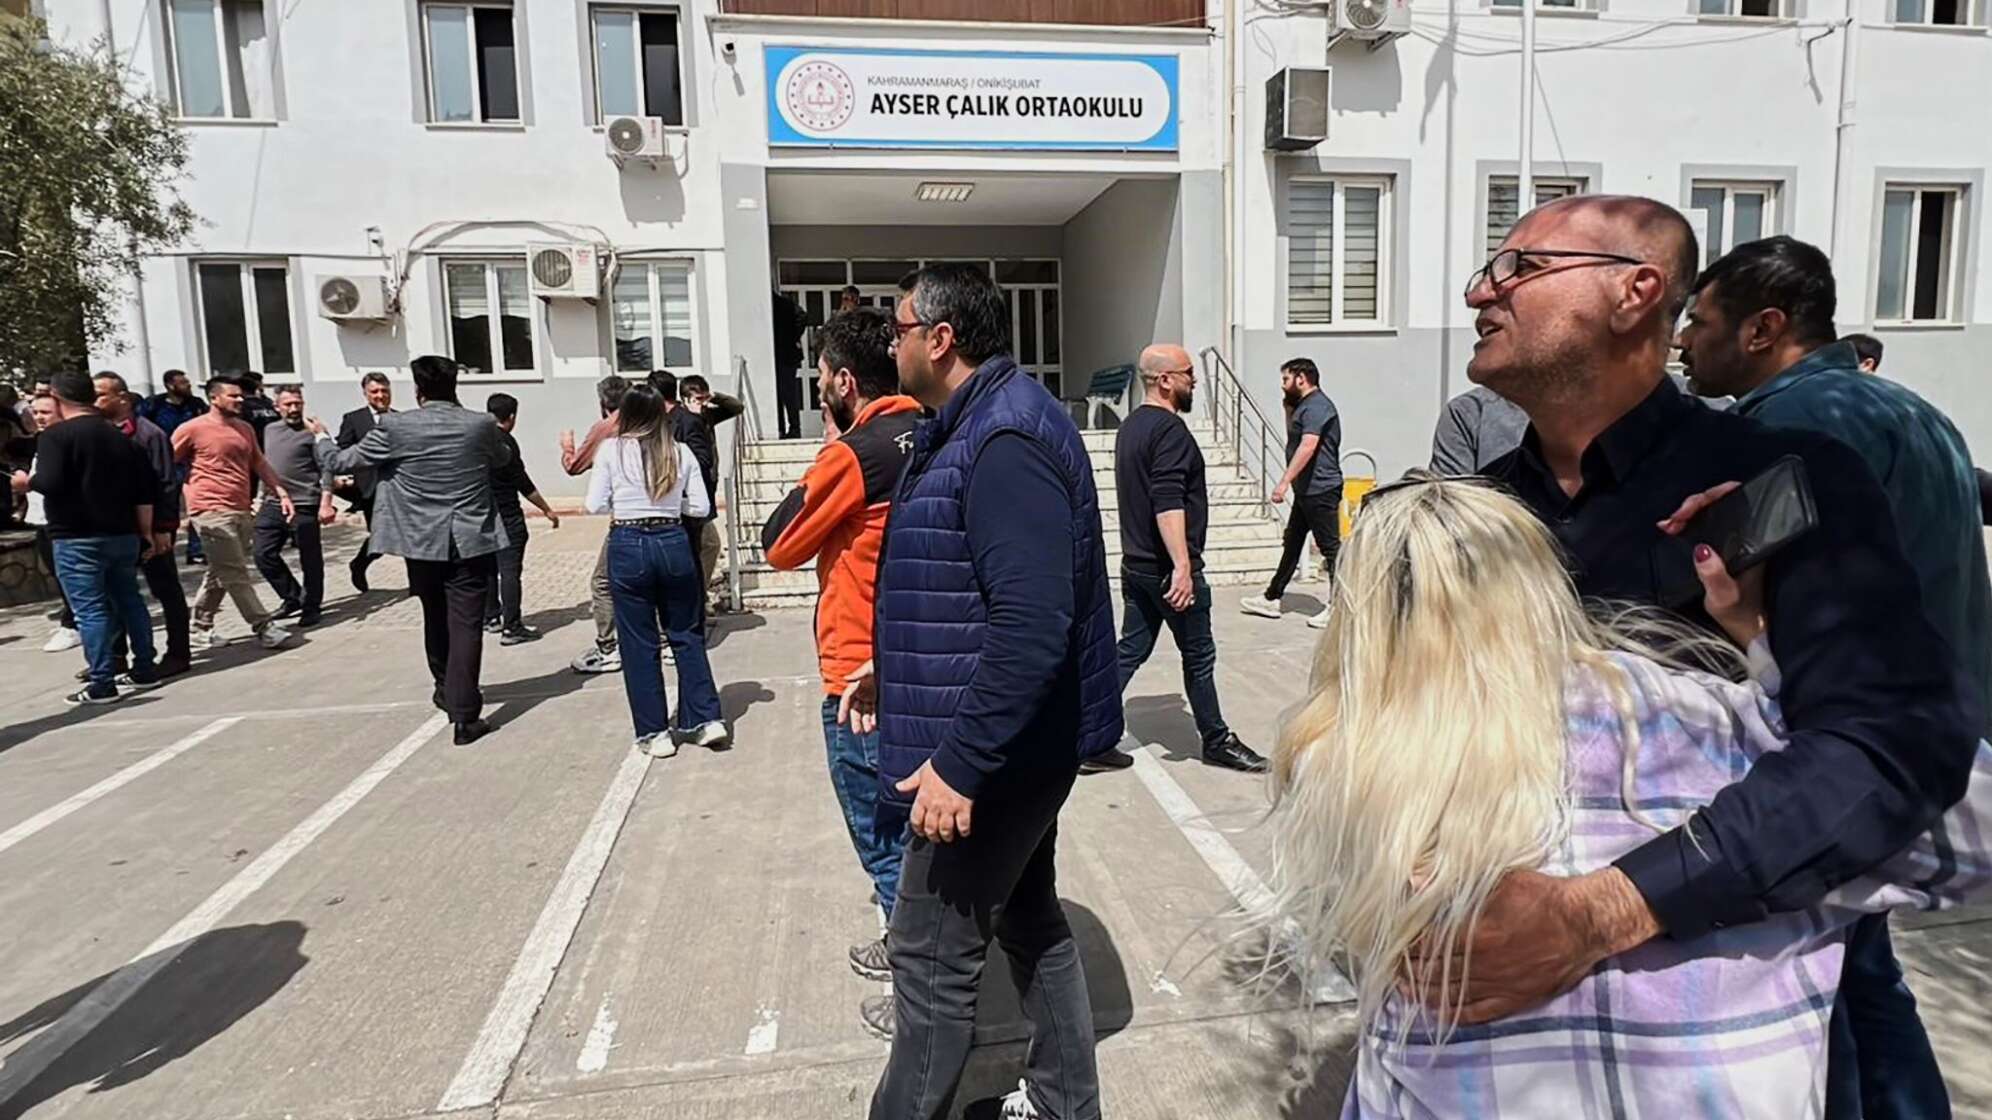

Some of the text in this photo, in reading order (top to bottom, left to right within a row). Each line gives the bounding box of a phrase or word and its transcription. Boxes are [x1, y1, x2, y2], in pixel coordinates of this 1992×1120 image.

[867, 76, 968, 90] KAHRAMANMARAŞ
[870, 93, 1143, 119] AYSER ÇALIK ORTAOKULU
